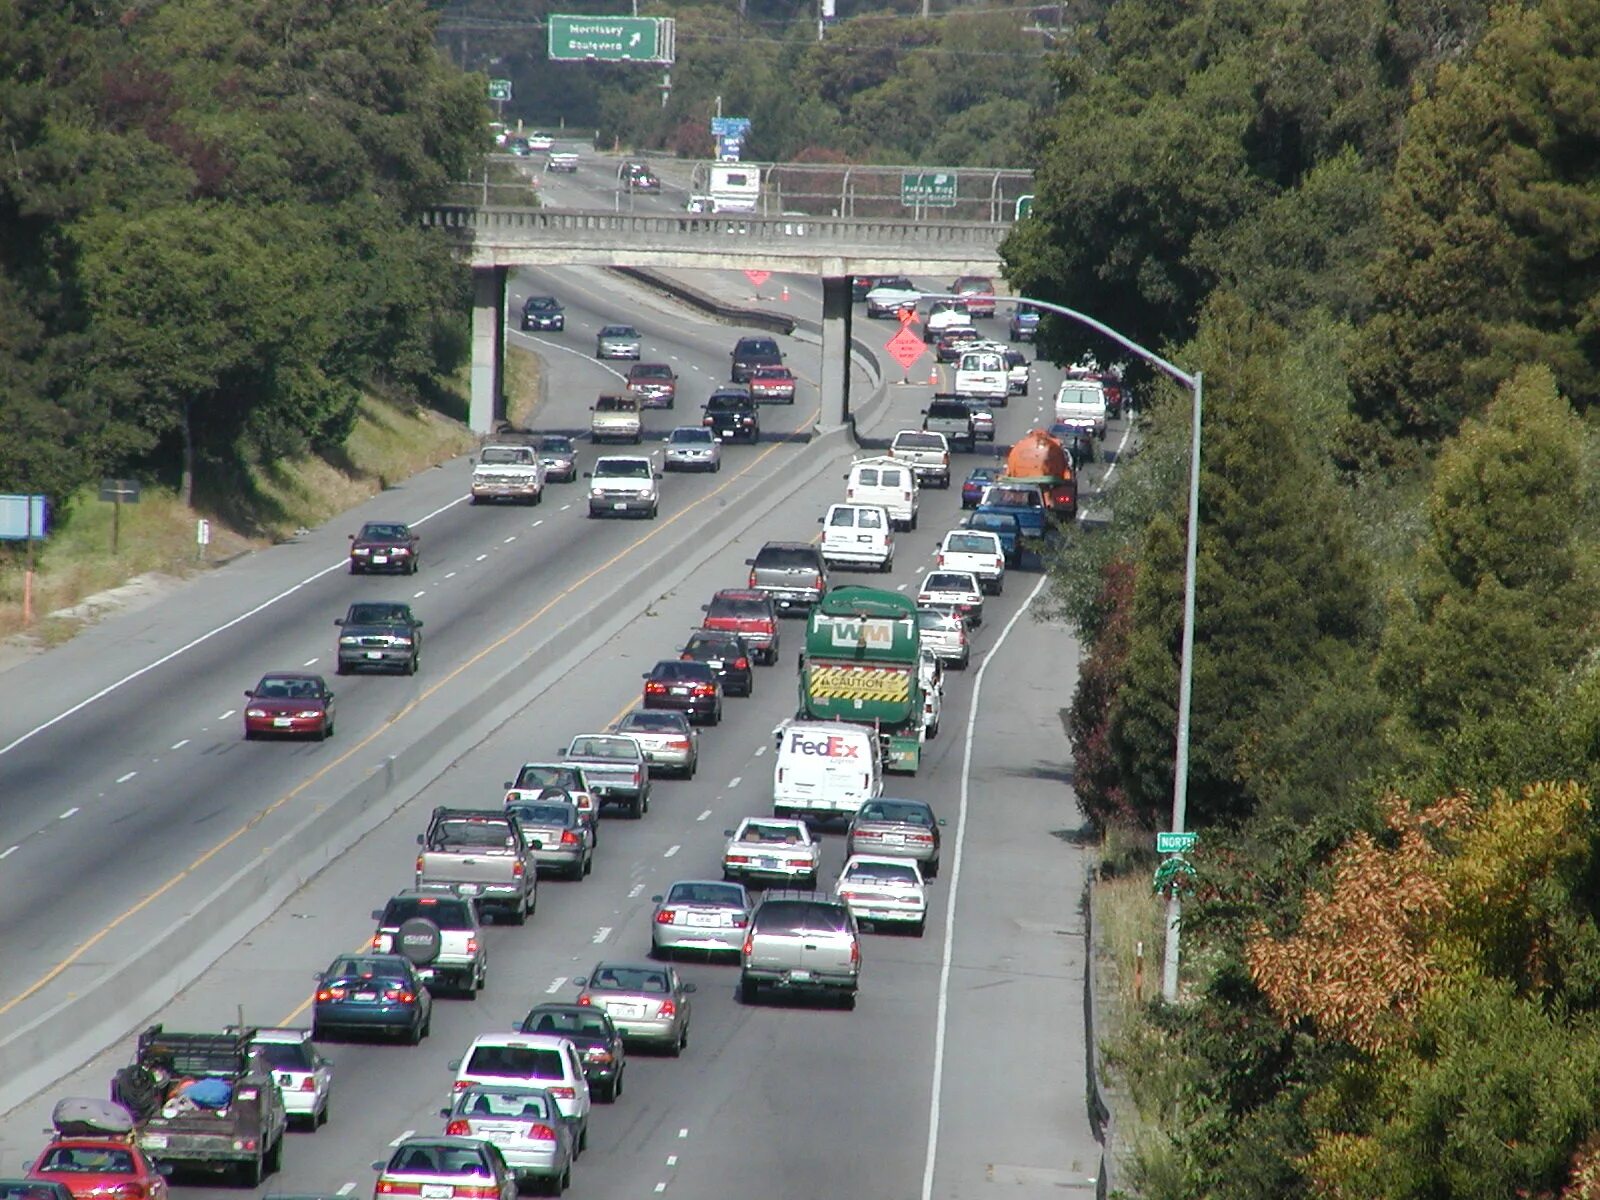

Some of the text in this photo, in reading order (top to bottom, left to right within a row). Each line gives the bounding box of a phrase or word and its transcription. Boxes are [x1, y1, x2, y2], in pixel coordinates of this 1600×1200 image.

[569, 24, 623, 37] Morrissey
[835, 624, 890, 642] WM
[831, 677, 883, 689] CAUTION
[790, 733, 859, 758] FedEx
